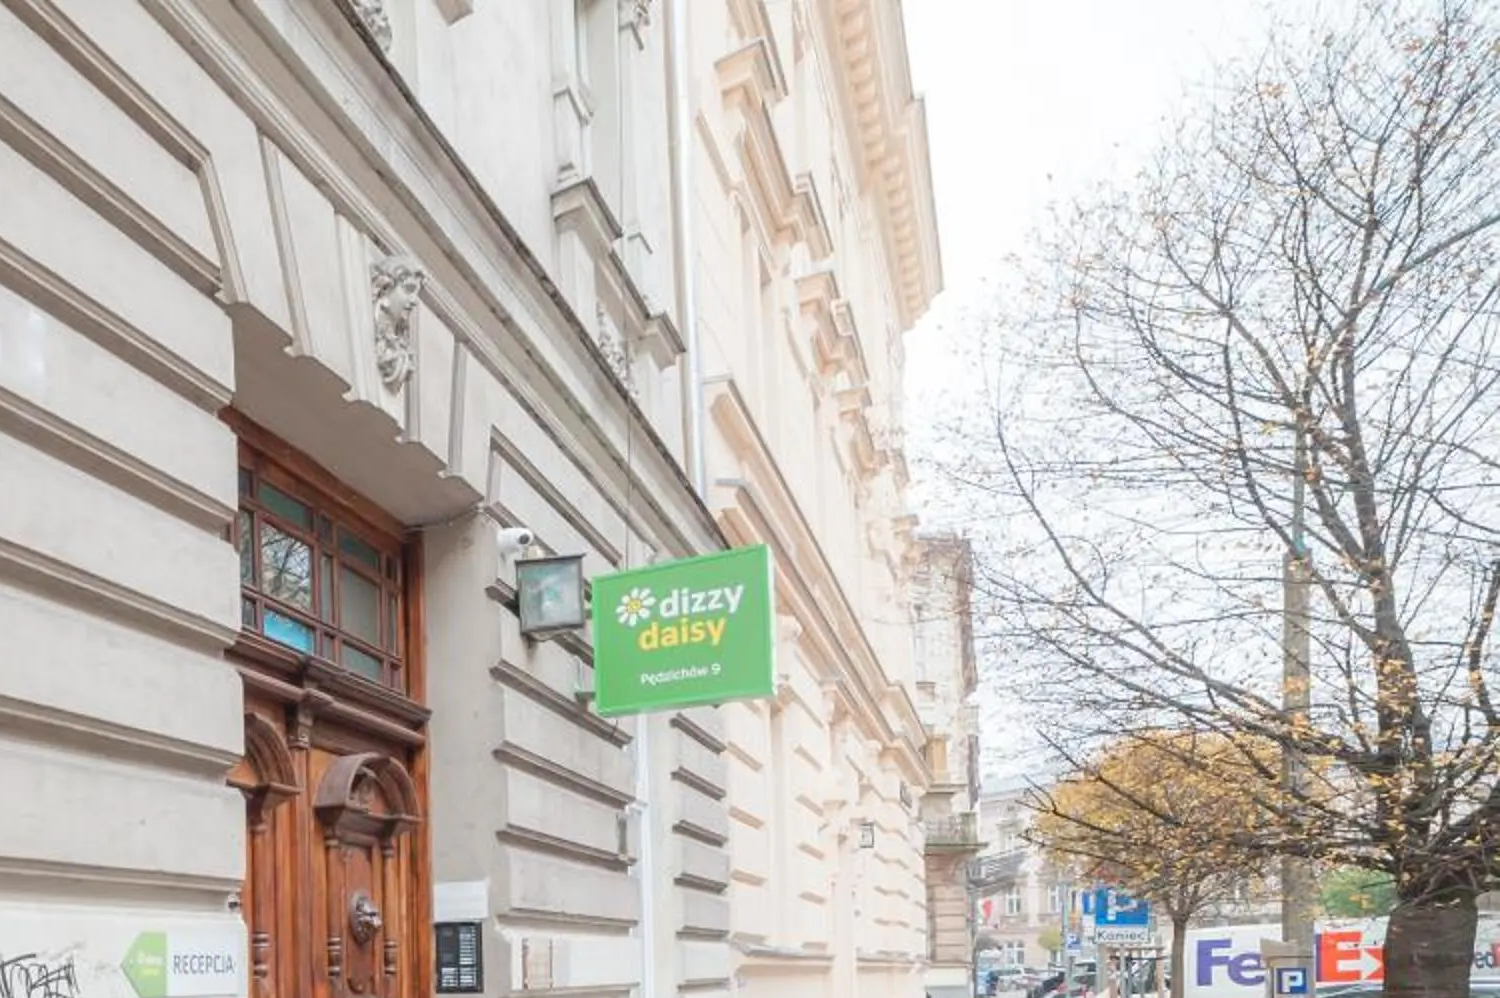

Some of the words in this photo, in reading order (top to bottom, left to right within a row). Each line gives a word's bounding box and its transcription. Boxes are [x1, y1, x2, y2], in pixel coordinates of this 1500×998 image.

[660, 584, 744, 618] dizzy
[639, 617, 726, 651] daisy
[173, 953, 236, 976] RECEPCJA
[1281, 970, 1303, 993] P
